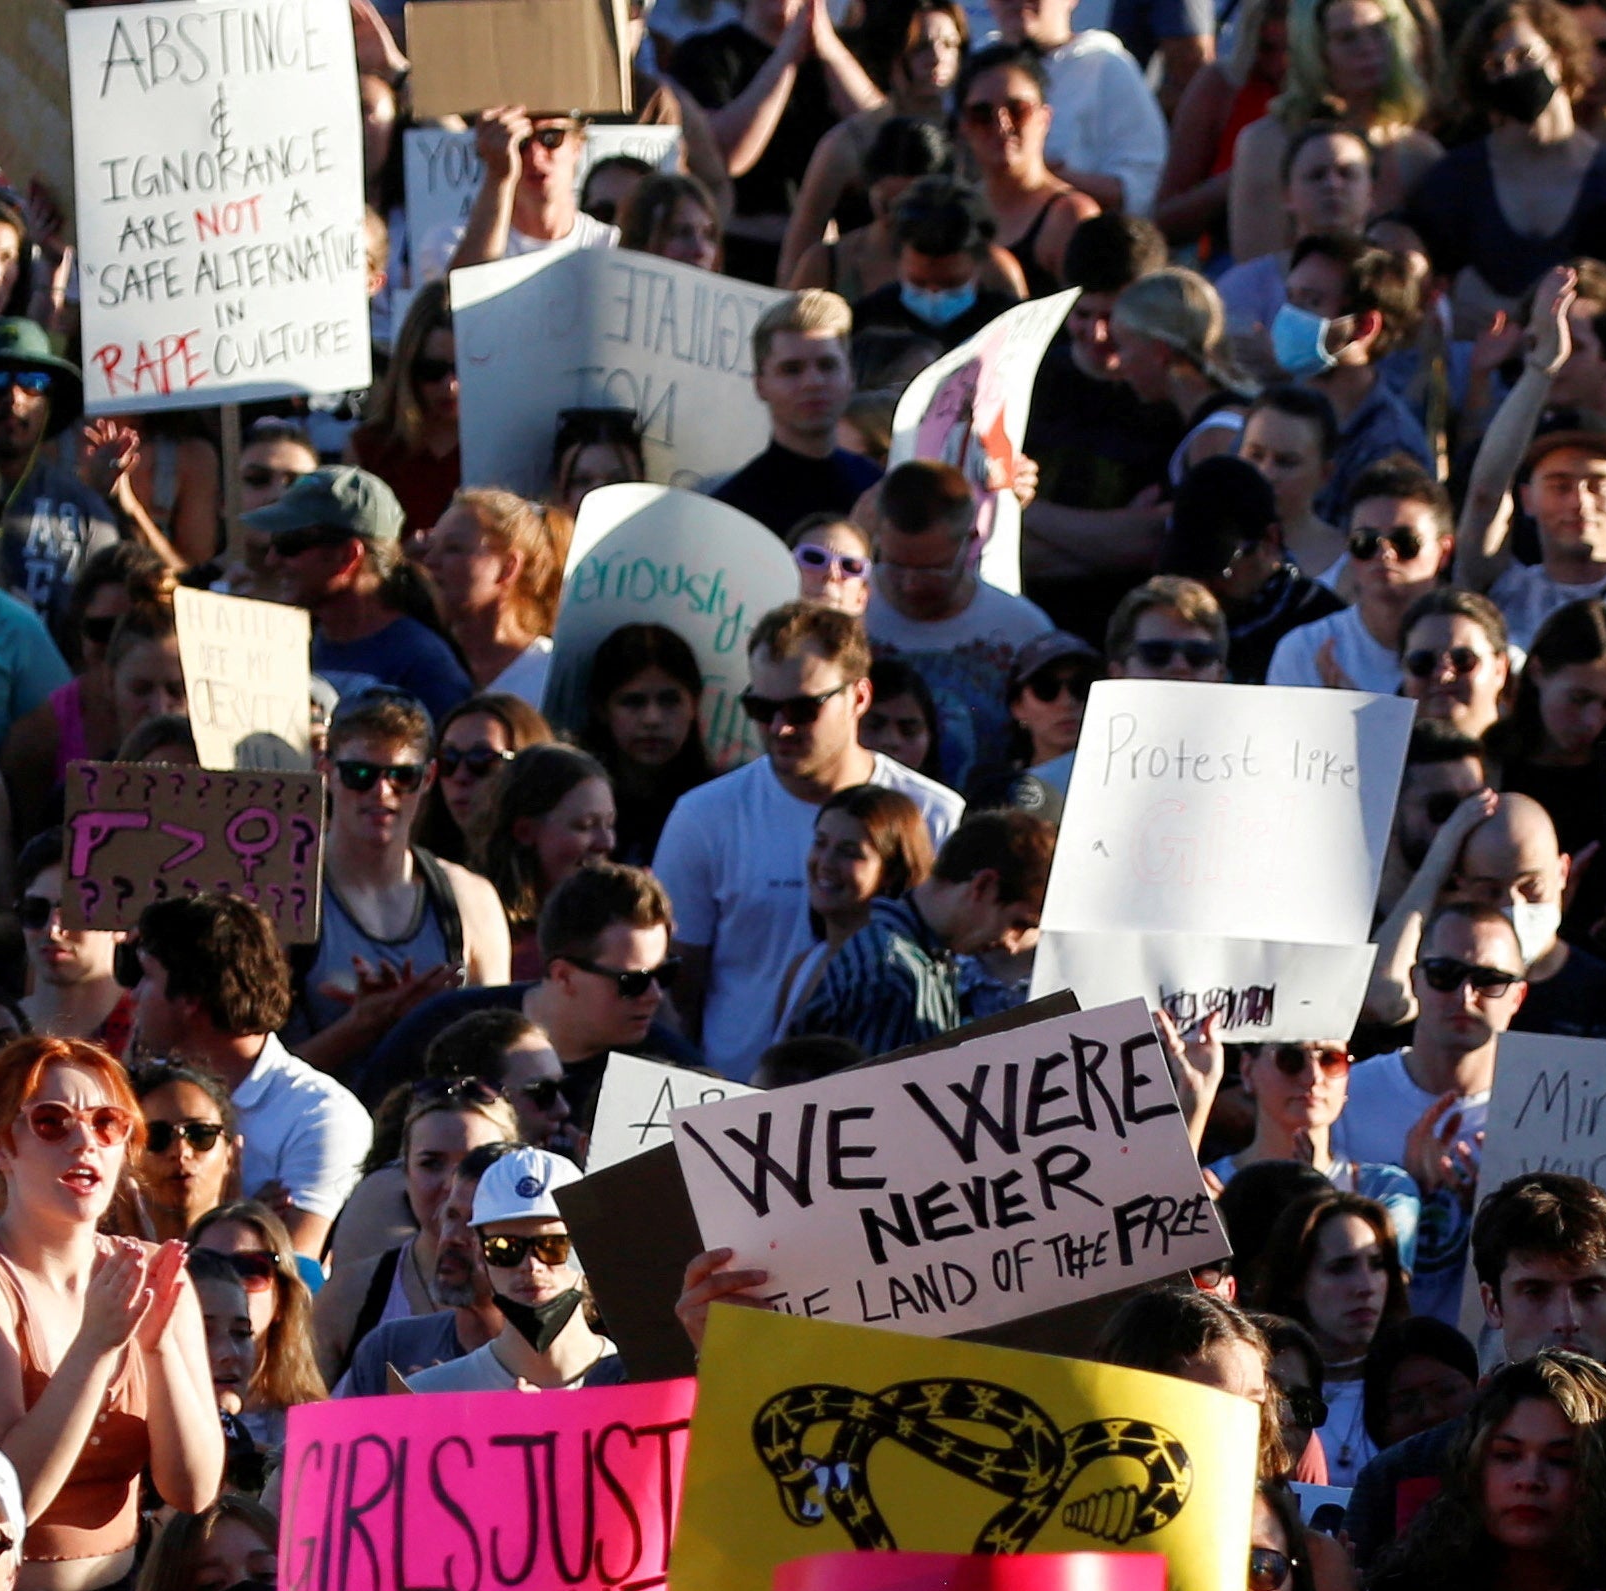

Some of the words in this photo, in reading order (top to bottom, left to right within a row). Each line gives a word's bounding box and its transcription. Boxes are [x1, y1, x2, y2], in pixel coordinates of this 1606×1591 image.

[98, 8, 330, 98] ABSTINCE
[209, 83, 236, 153] &
[99, 126, 335, 202] IGNORANCE
[118, 214, 187, 254] ARE
[192, 195, 264, 242] NOT
[284, 191, 316, 222] A
[213, 299, 246, 329] IN
[94, 328, 214, 397] RAPE
[211, 319, 353, 378] CULTURE
[1103, 712, 1262, 786] Protest
[1293, 739, 1357, 789] like
[681, 1103, 887, 1217] WE
[903, 1032, 1180, 1164] WERE
[859, 1144, 1104, 1265] NEVER
[858, 1261, 977, 1324] LAND
[992, 1238, 1037, 1294] OF
[1112, 1193, 1212, 1266] FREE
[488, 1419, 692, 1588] JUST
